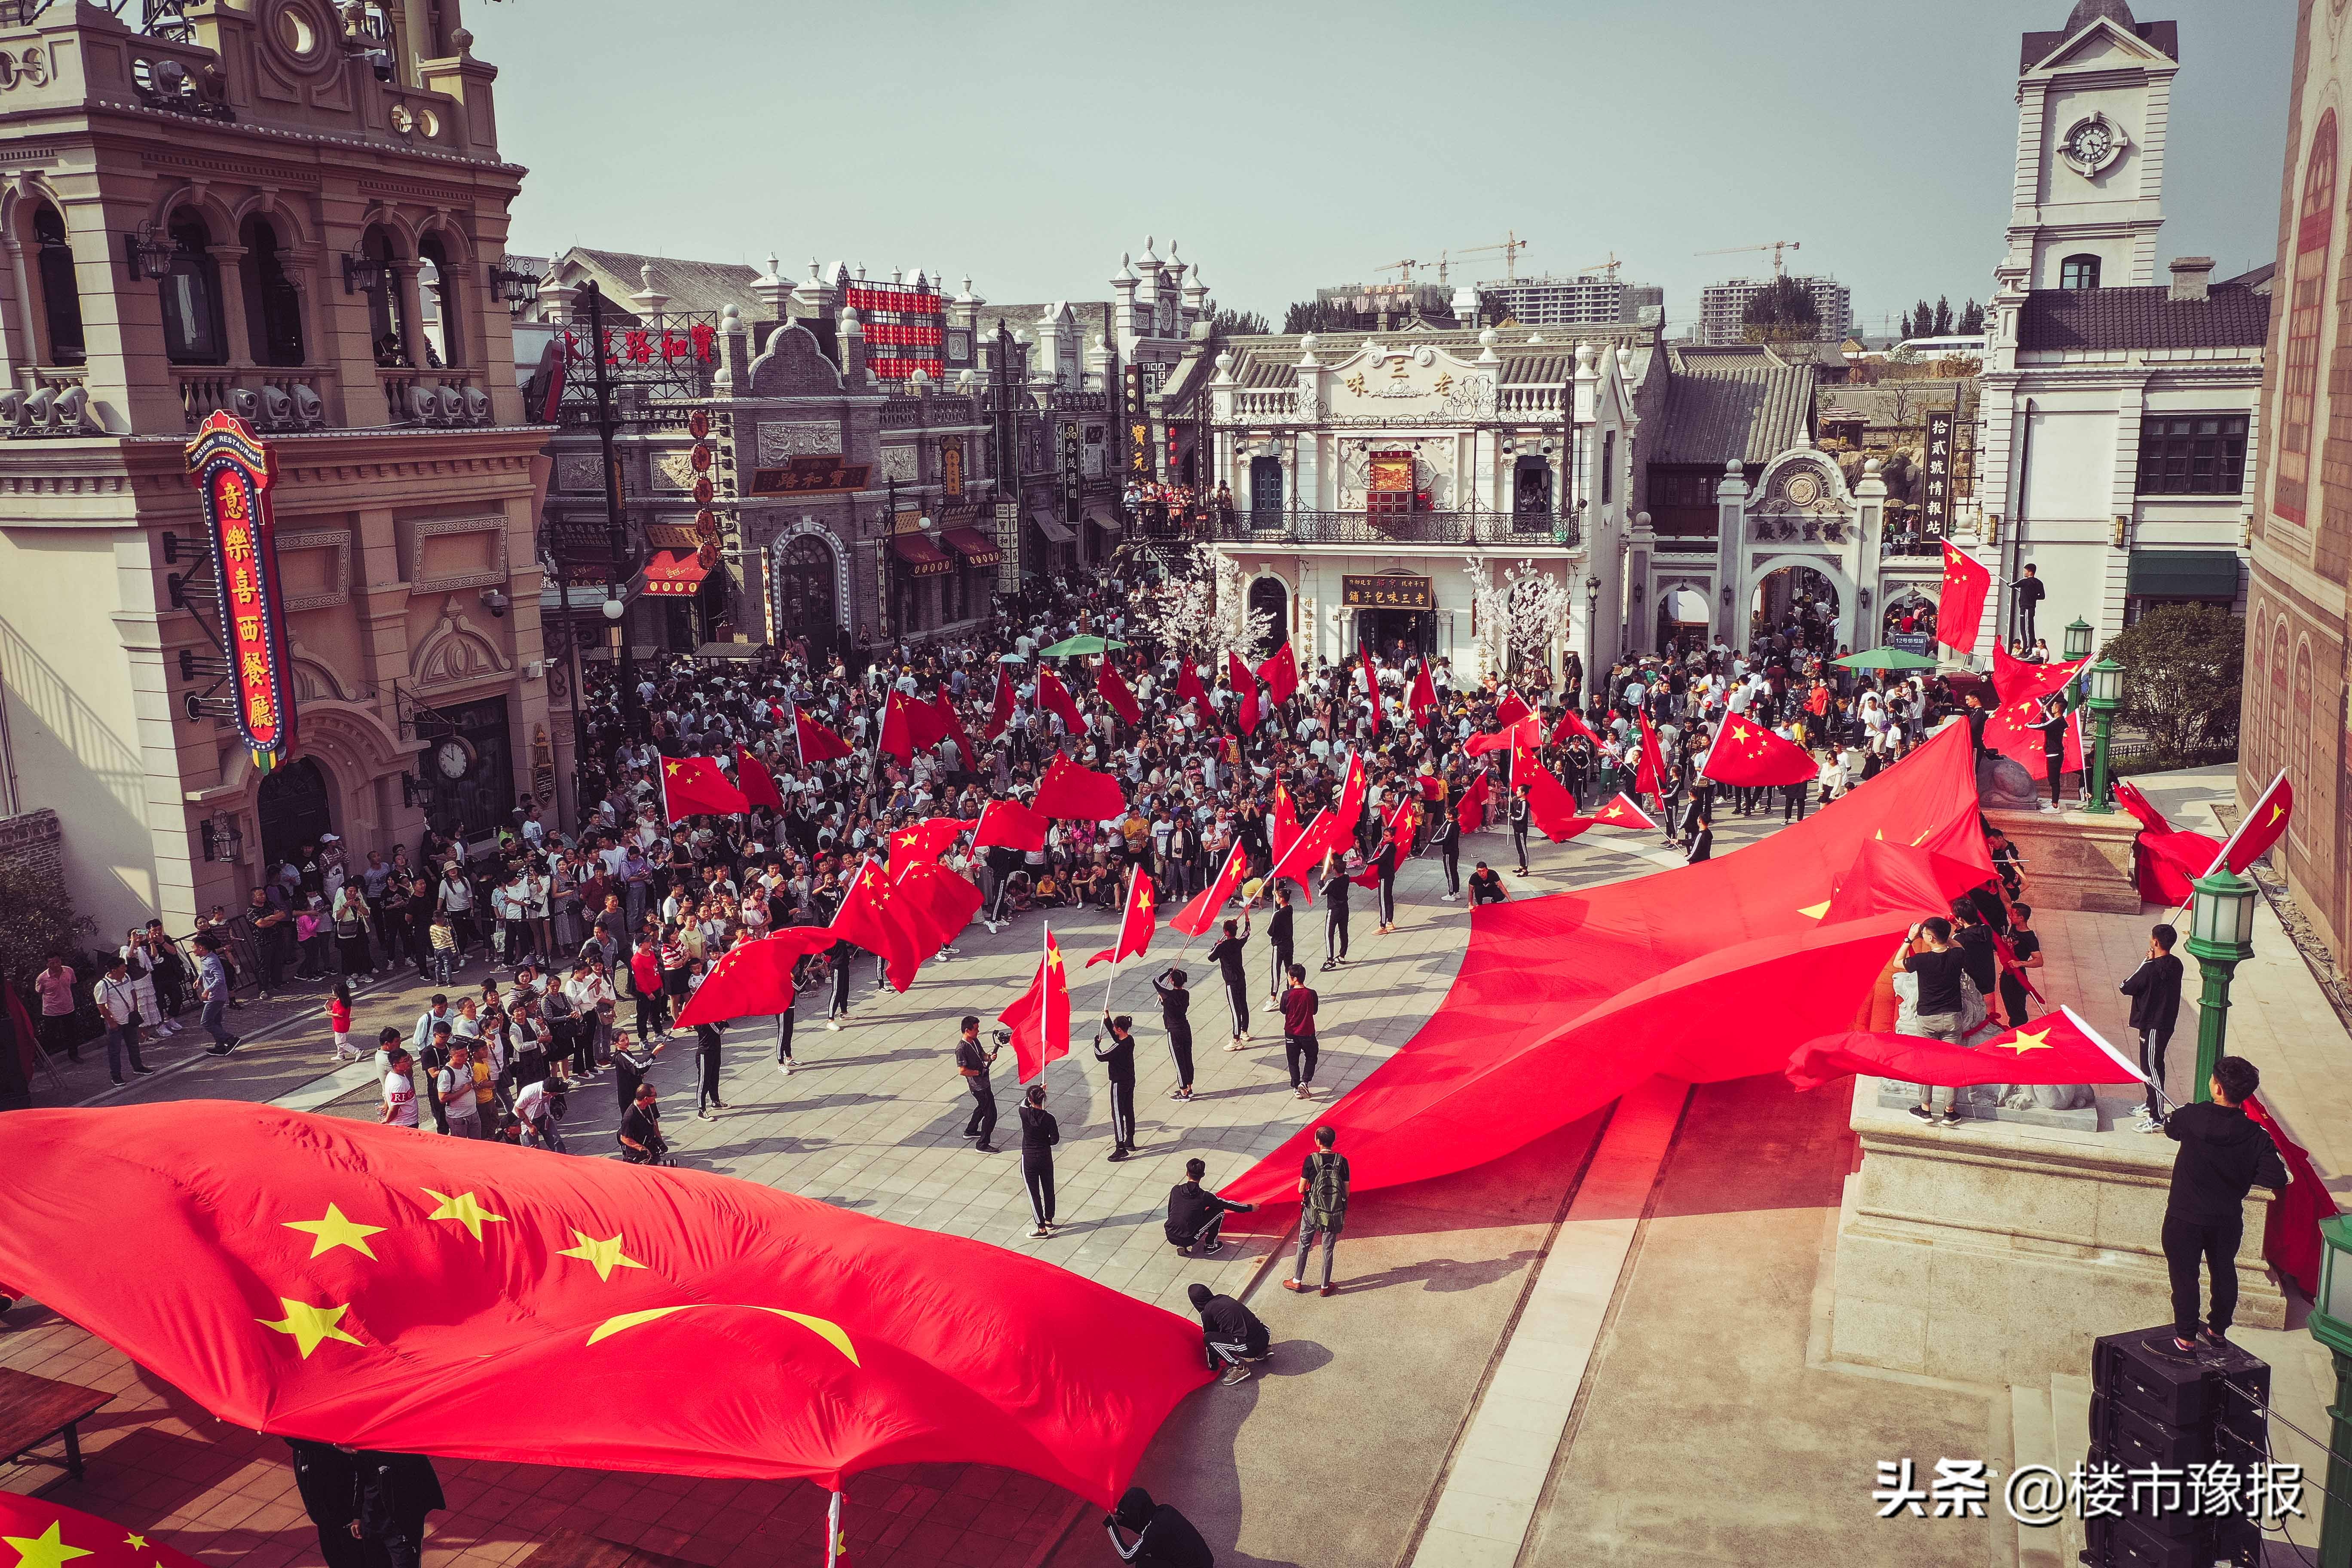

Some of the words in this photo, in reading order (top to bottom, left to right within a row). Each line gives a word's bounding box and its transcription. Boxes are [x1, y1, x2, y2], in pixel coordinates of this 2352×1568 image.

[1346, 358, 1454, 397] 老三味
[191, 439, 215, 462] WESTERN
[219, 436, 260, 463] RESTAURANT
[1132, 424, 1149, 484] 寶元
[775, 469, 847, 489] 寶和路
[1925, 420, 1949, 535] 拾貳號情報站
[219, 482, 274, 729] 意樂喜西餐廳
[1348, 591, 1425, 605] 老三味包子鋪
